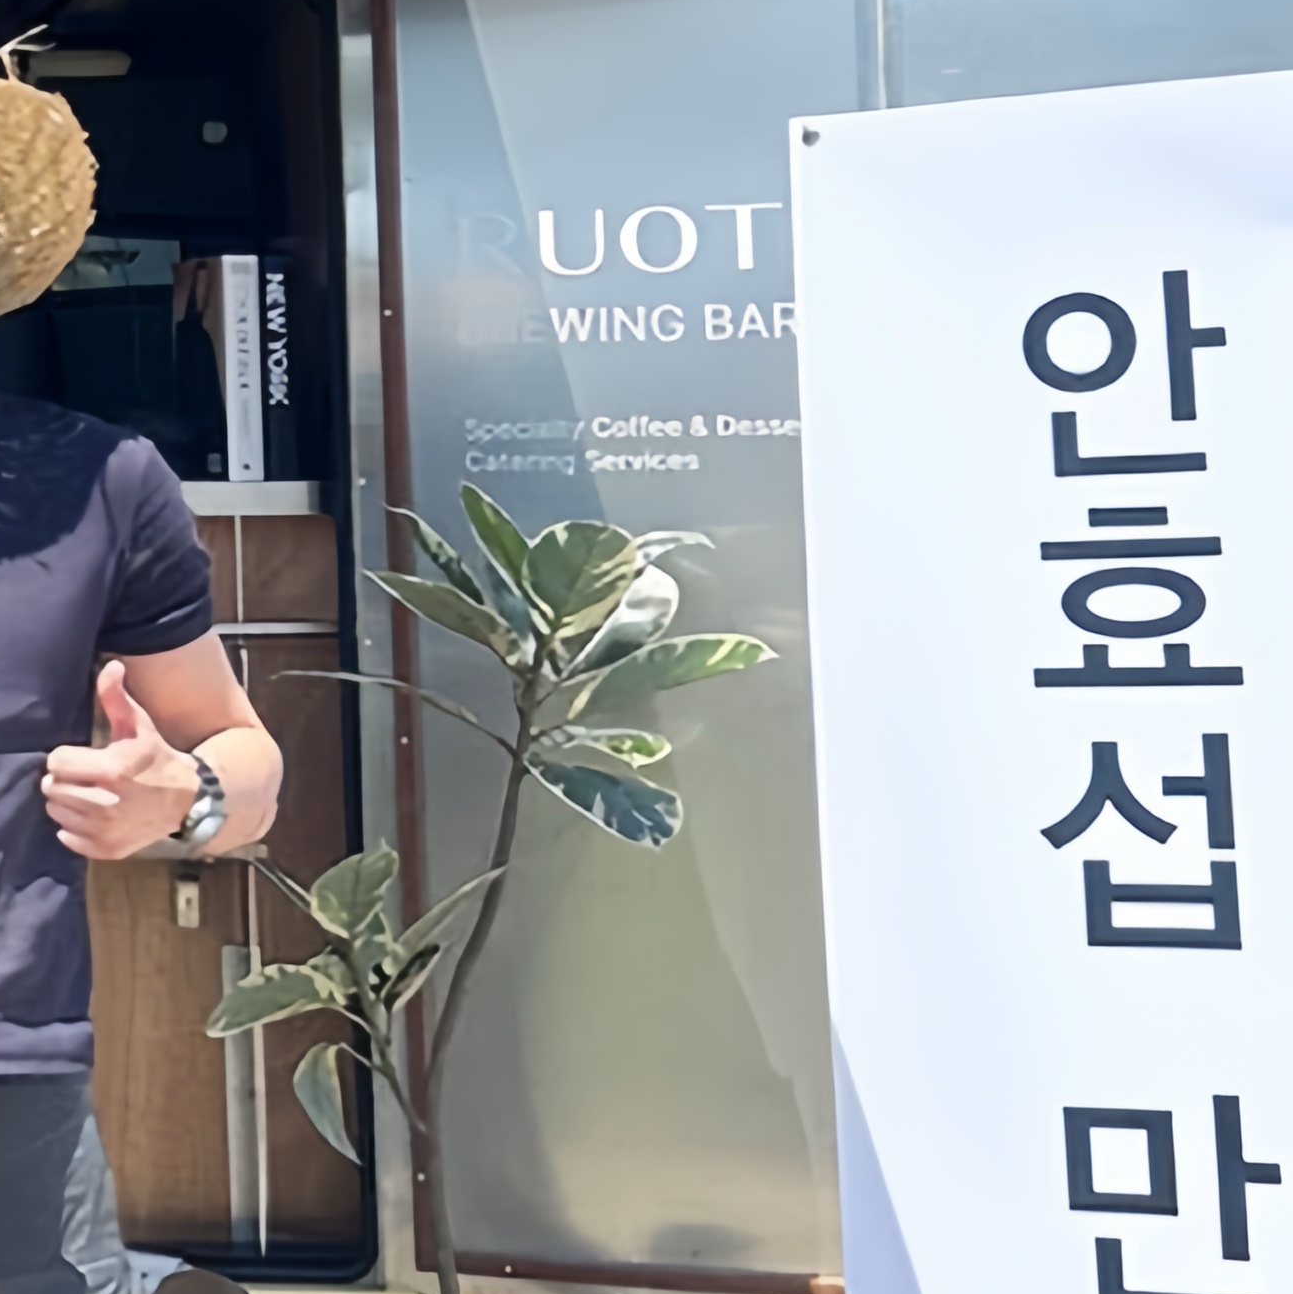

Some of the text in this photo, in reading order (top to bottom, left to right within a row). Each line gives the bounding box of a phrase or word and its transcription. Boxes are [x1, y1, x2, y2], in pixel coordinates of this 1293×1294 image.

[457, 201, 784, 276] RUOT
[264, 273, 288, 334] NEW
[590, 414, 684, 439] Coffee
[689, 414, 709, 438] &
[716, 414, 803, 438] Desse
[464, 449, 700, 476] Catering Services
[1021, 269, 1245, 951] 안효섭
